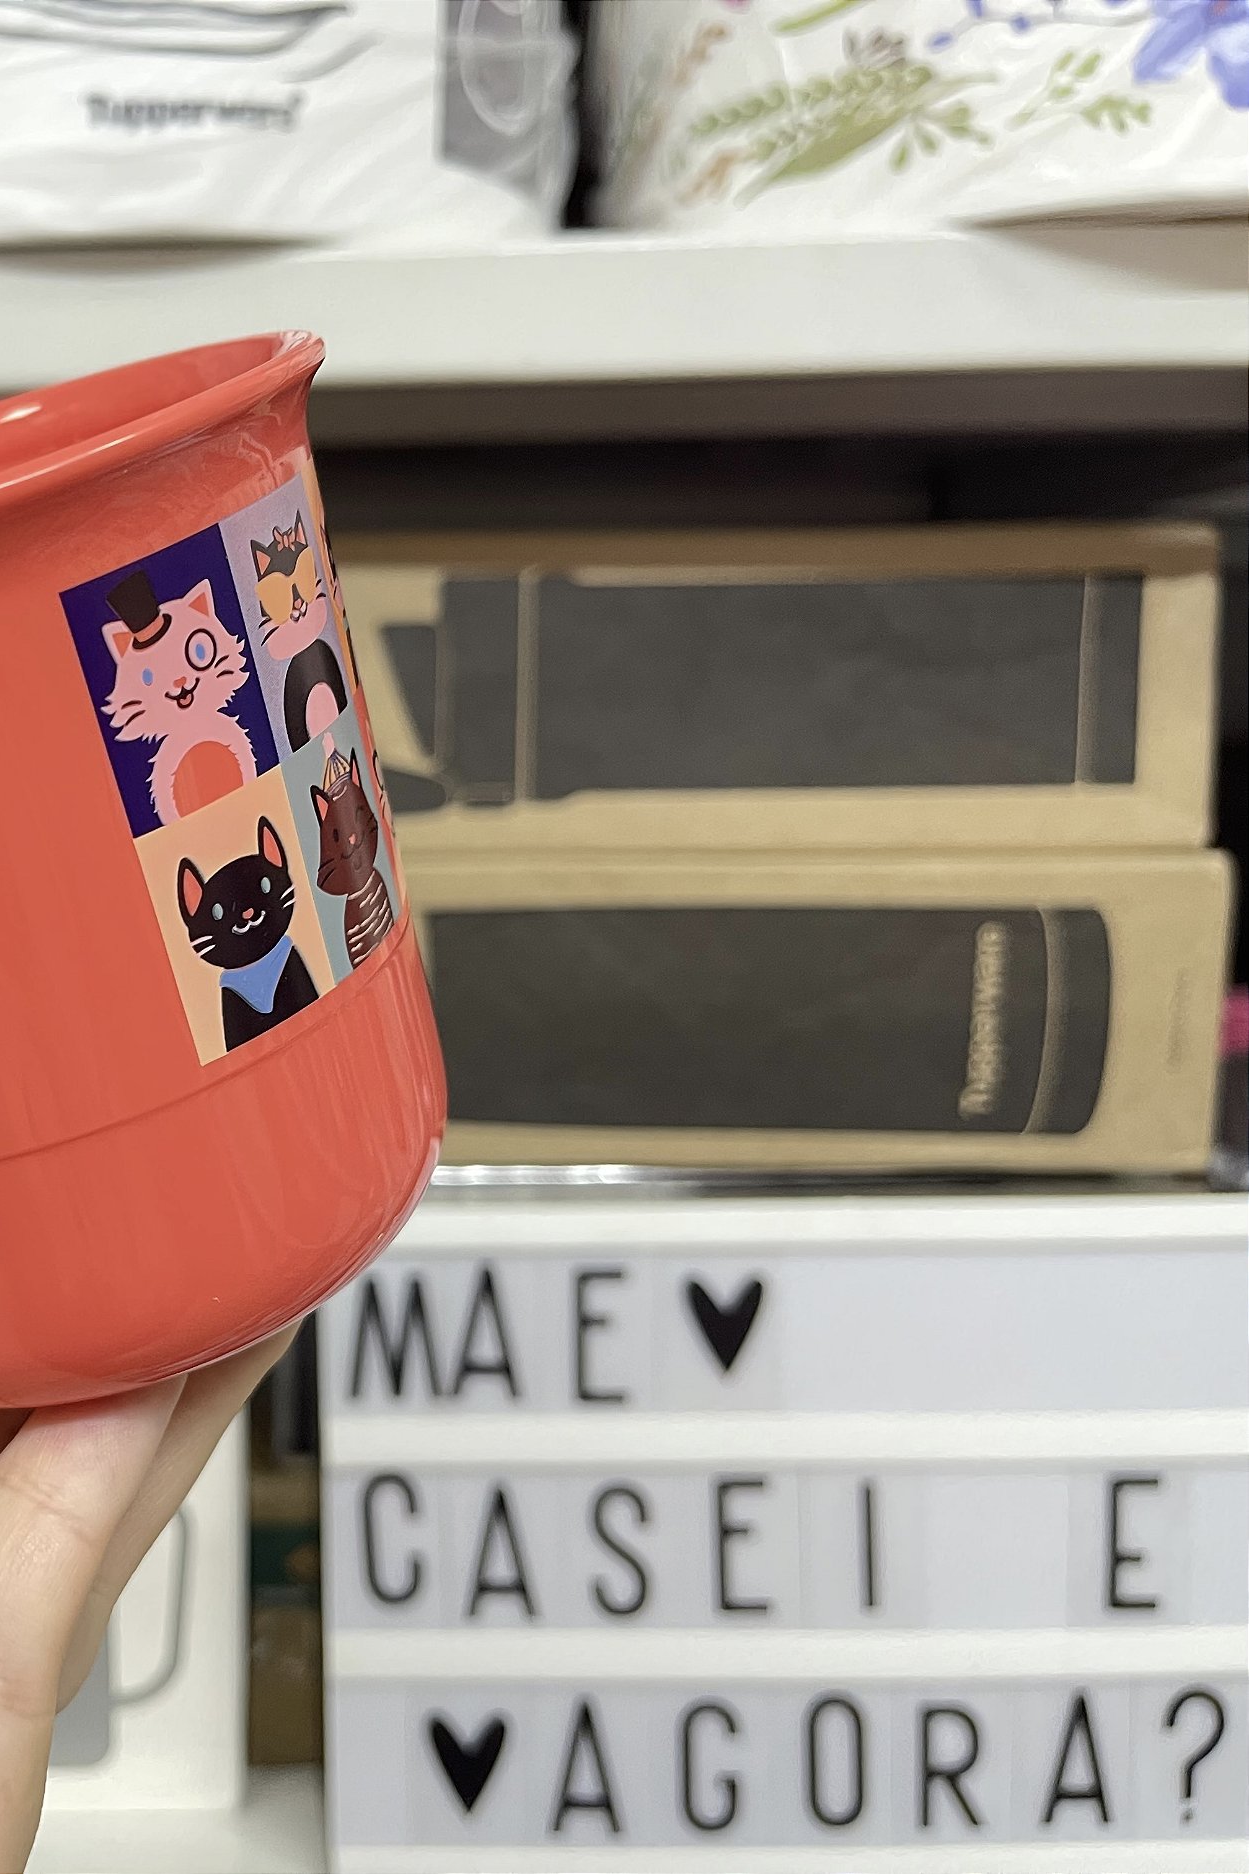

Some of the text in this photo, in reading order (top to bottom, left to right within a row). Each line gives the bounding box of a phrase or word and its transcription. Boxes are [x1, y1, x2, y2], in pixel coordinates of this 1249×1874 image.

[352, 1258, 627, 1401] MAE
[361, 1473, 1160, 1617] CASEI E
[552, 1689, 1227, 1834] AGORA?
